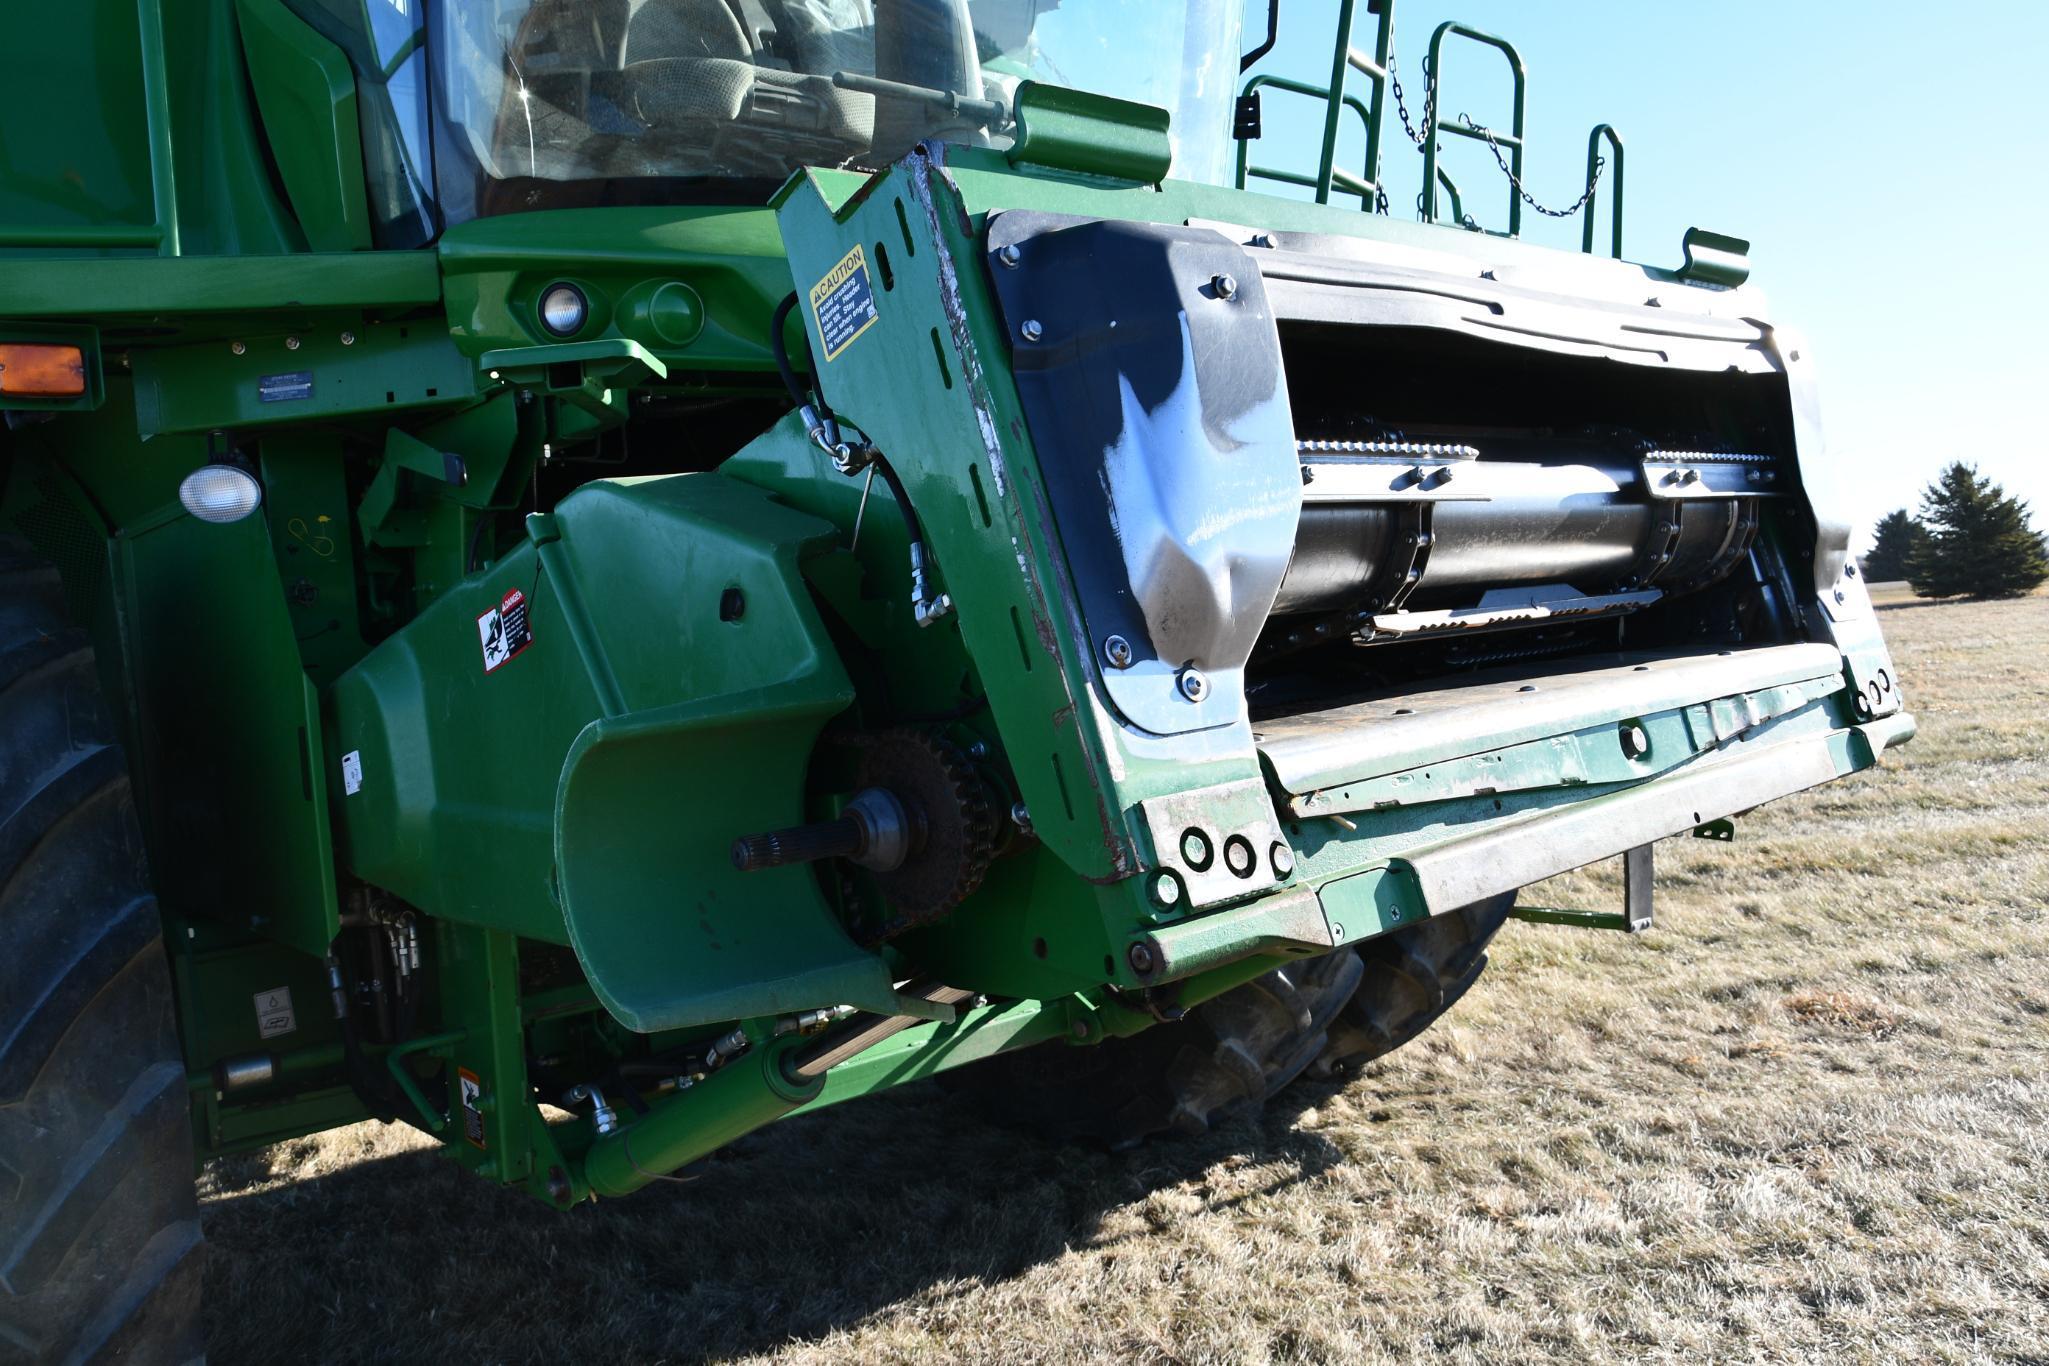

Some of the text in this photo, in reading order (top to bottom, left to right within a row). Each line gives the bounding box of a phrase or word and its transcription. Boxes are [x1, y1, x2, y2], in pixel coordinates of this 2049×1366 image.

[820, 250, 862, 296] CAUTION
[819, 277, 856, 314] Avoid crushing
[842, 284, 860, 304] Header
[823, 322, 834, 333] can
[843, 300, 855, 315] Stay
[826, 297, 870, 342] clear when engine
[828, 341, 834, 350] is
